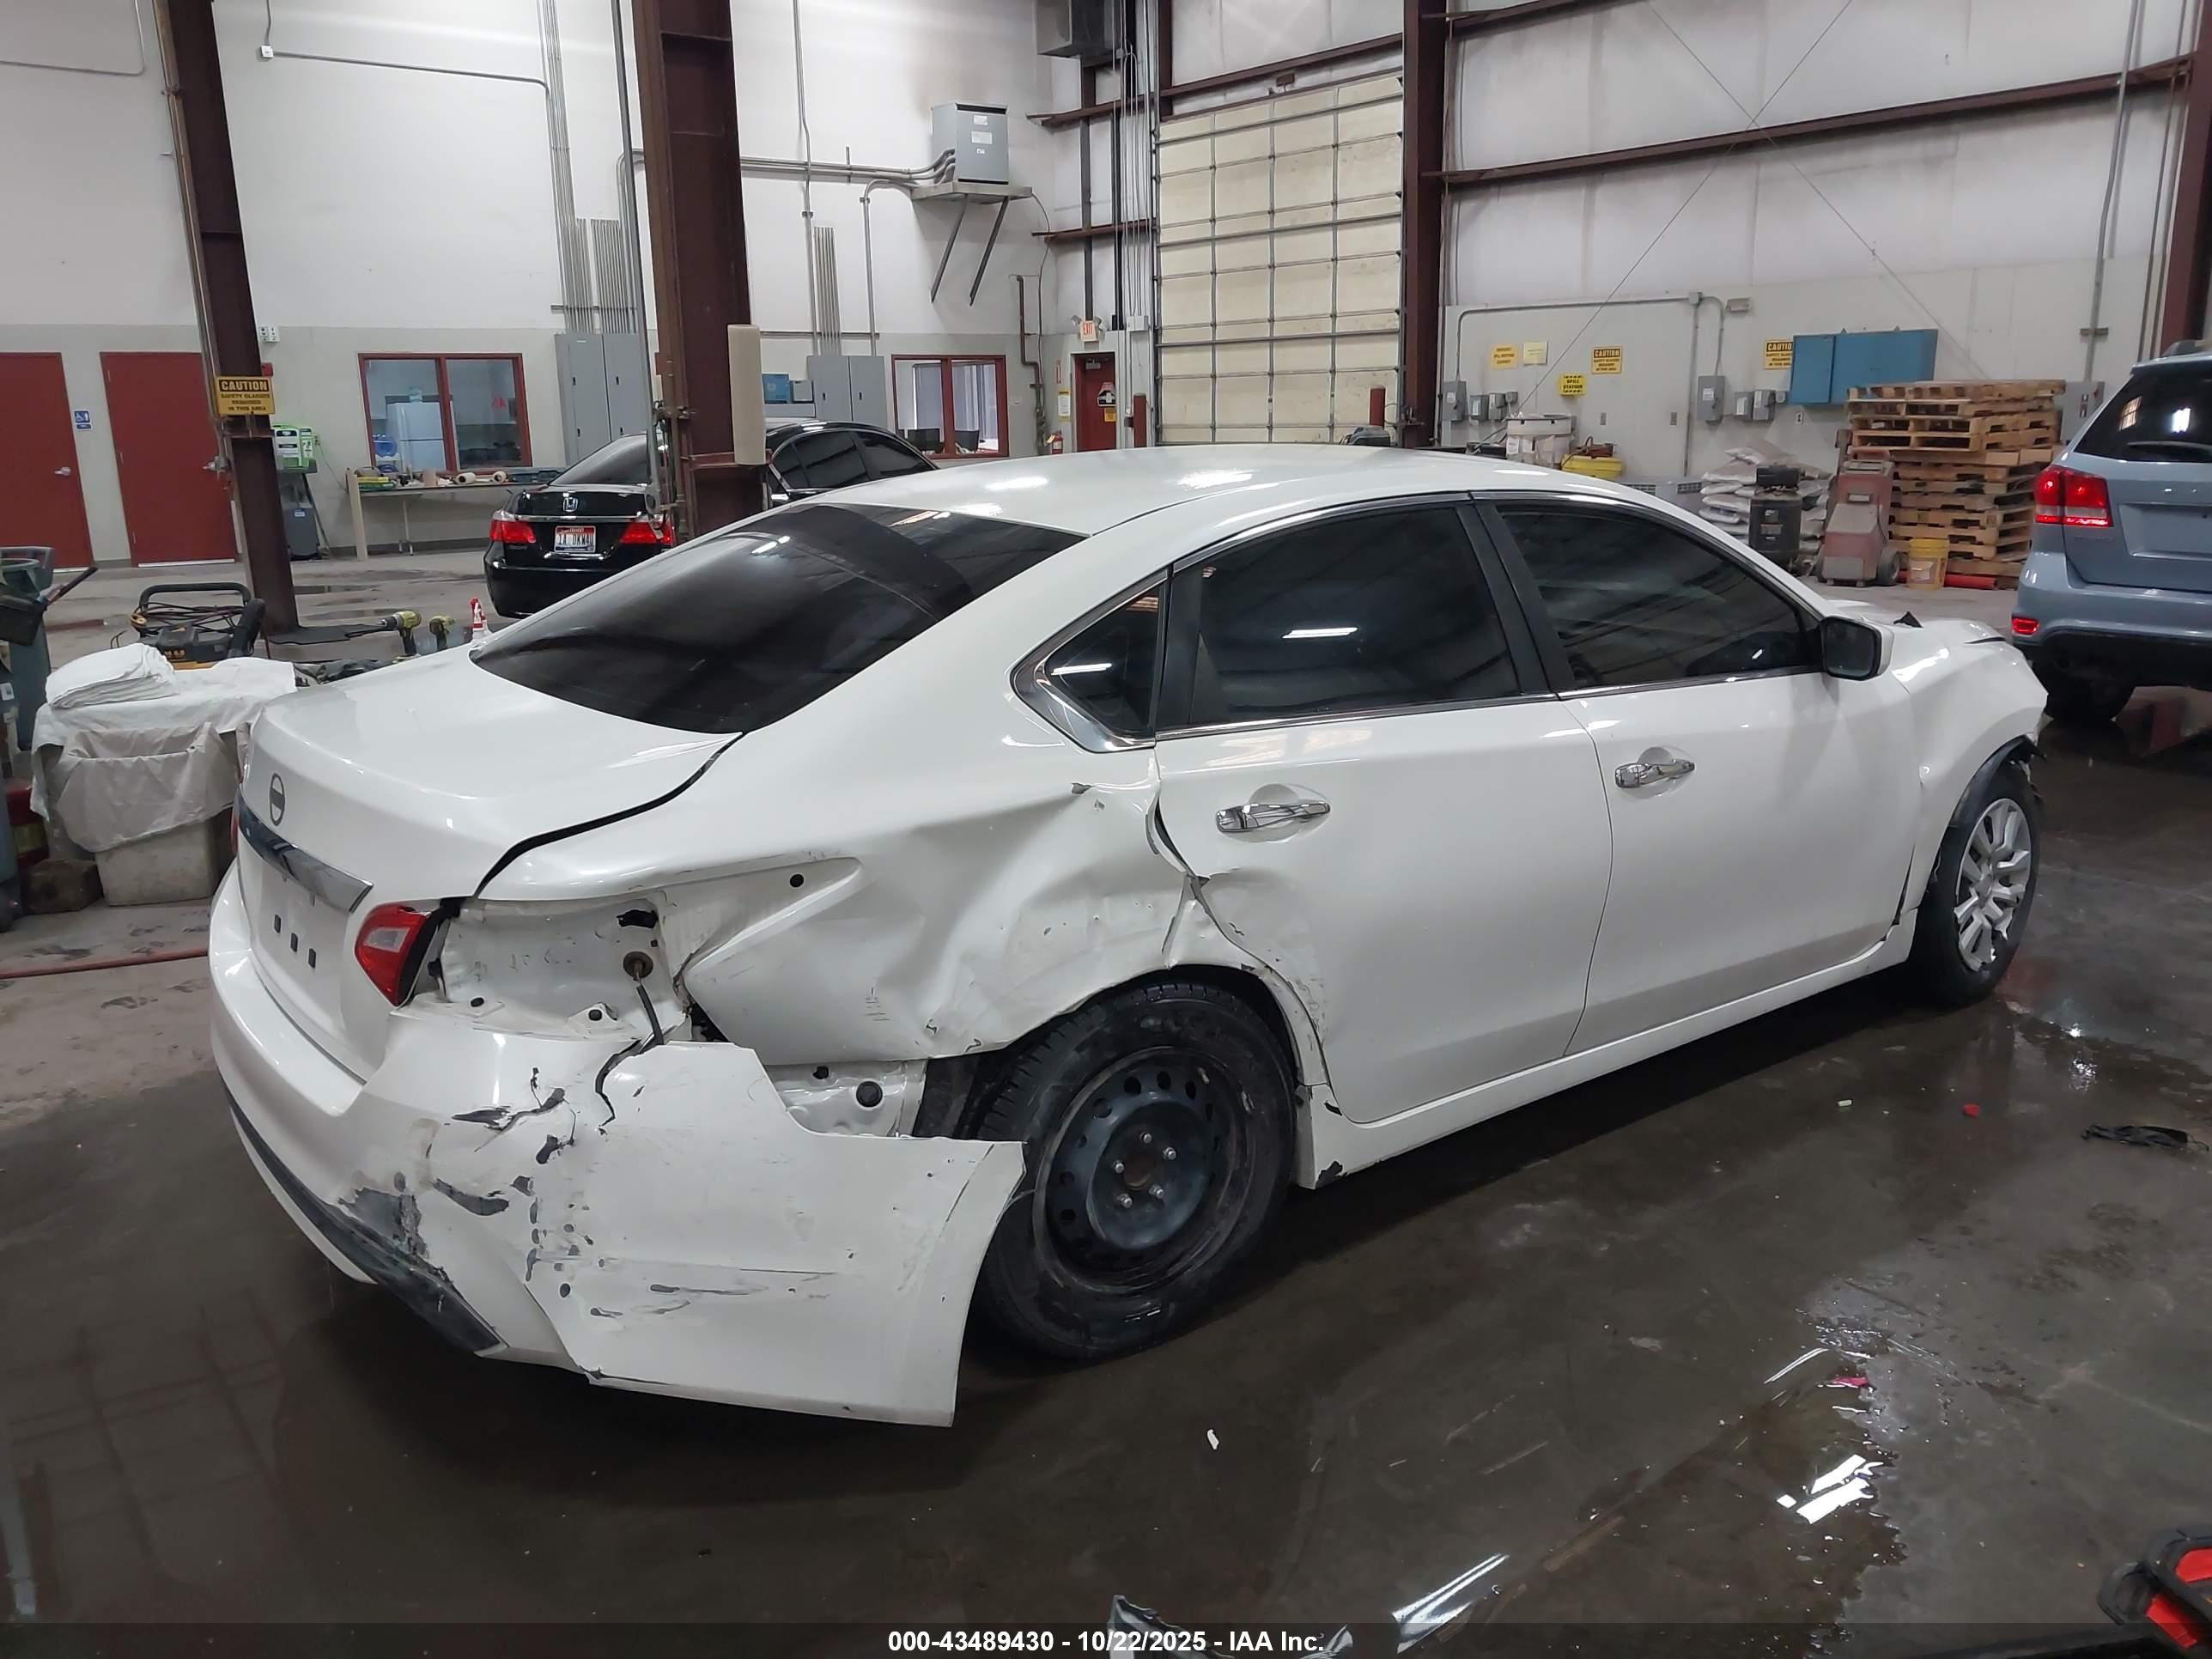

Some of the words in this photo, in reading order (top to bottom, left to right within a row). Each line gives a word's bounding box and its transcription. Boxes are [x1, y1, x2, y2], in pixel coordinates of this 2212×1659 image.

[1083, 322, 1093, 335] EXIT
[1767, 343, 1792, 351] CAUTIO
[221, 380, 268, 391] CAUTION
